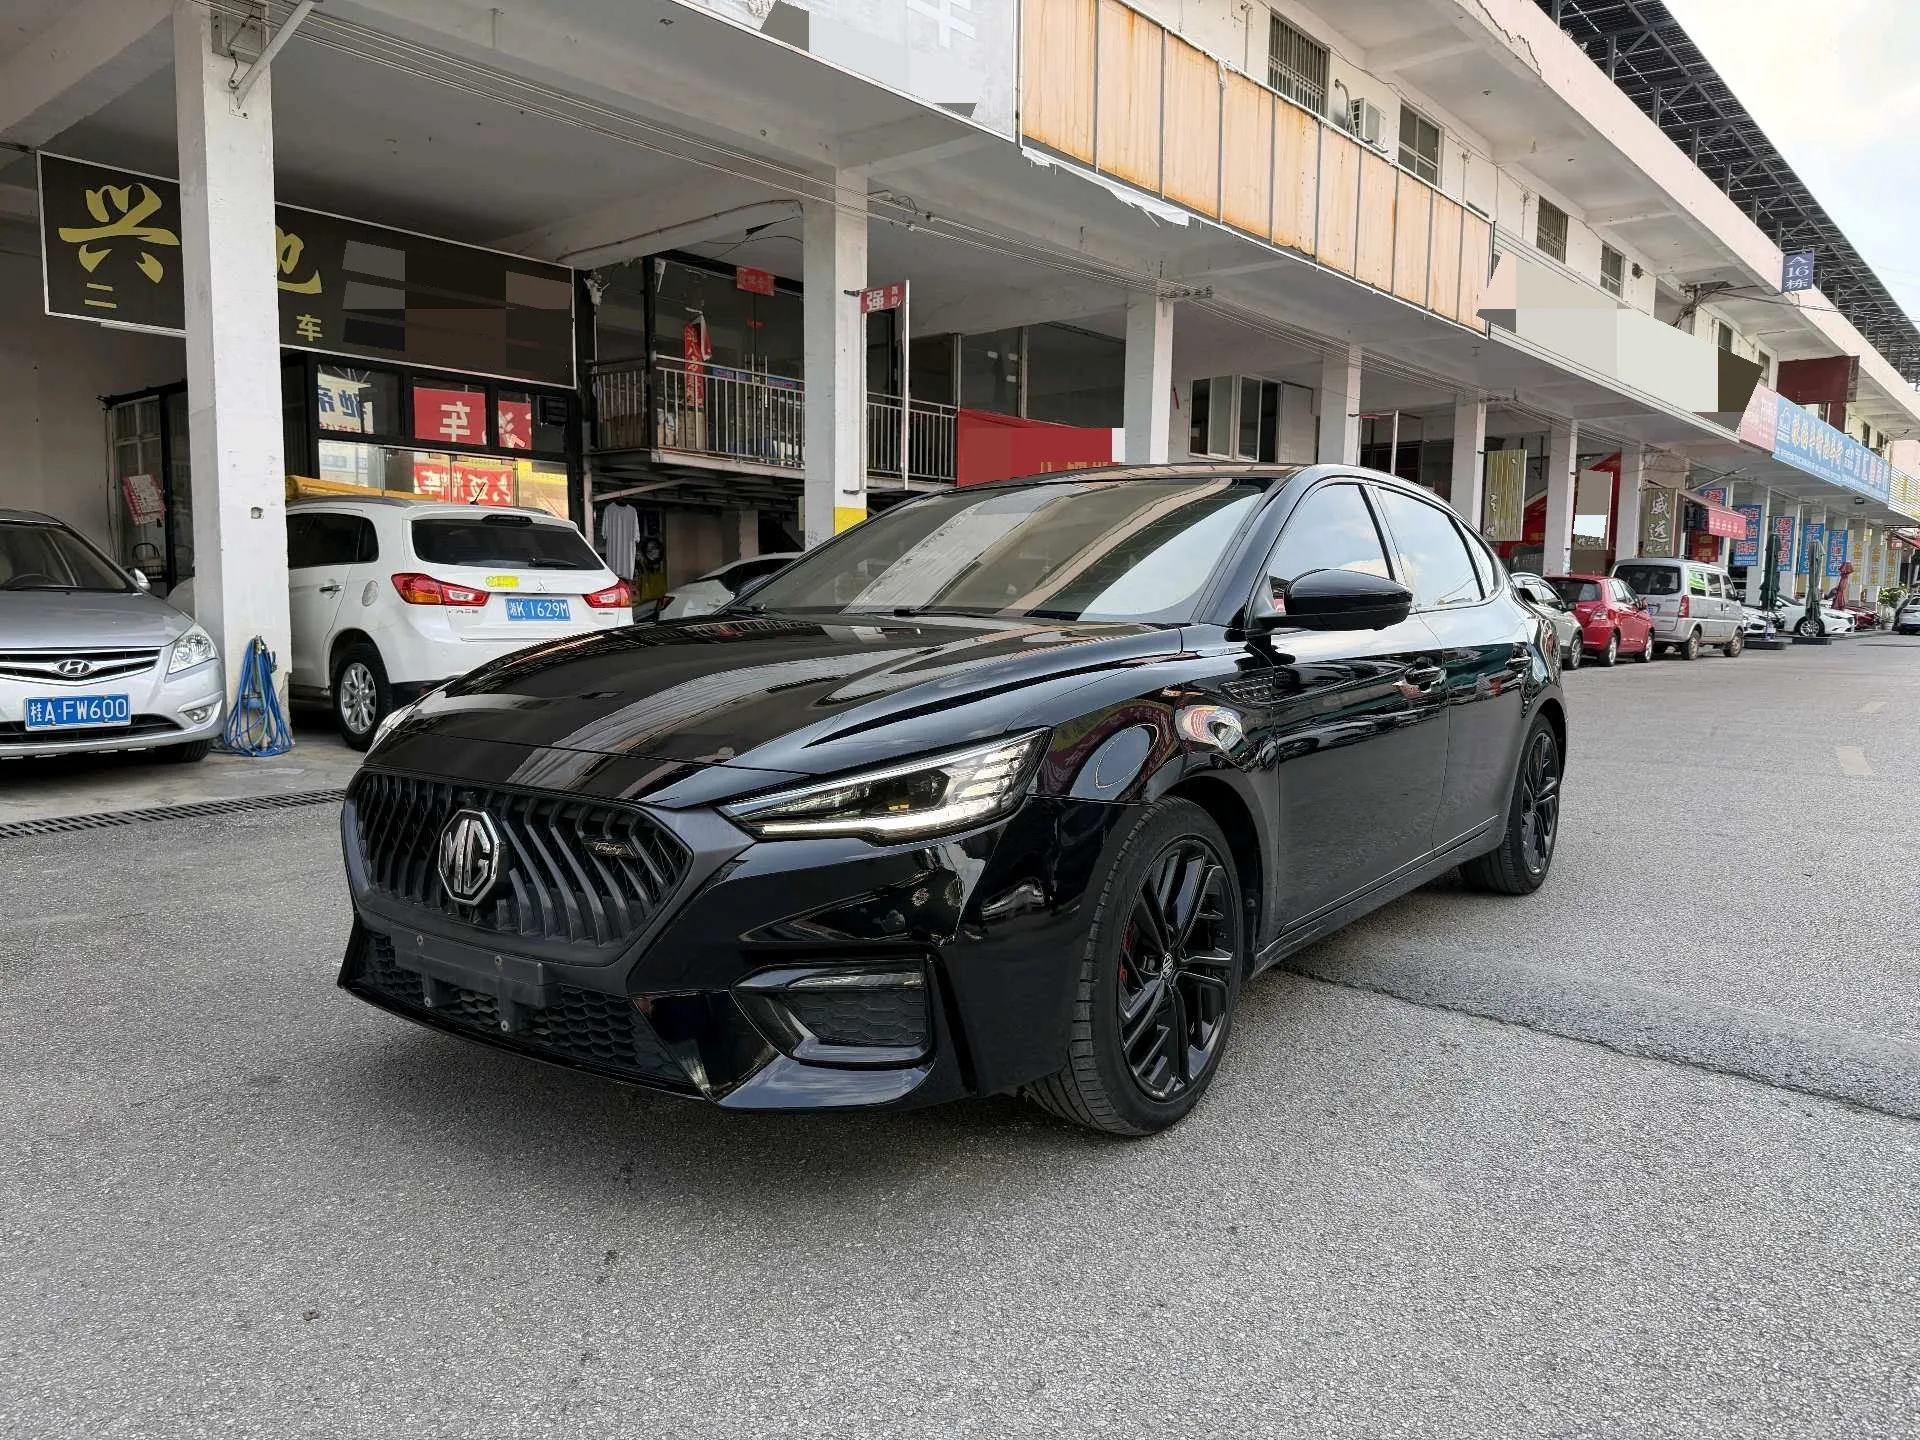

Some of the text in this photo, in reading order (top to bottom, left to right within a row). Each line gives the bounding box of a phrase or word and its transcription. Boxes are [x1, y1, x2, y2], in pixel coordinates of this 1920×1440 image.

[58, 183, 181, 284] 兴
[866, 289, 884, 312] 强
[296, 314, 323, 342] 车
[443, 817, 491, 897] MG
